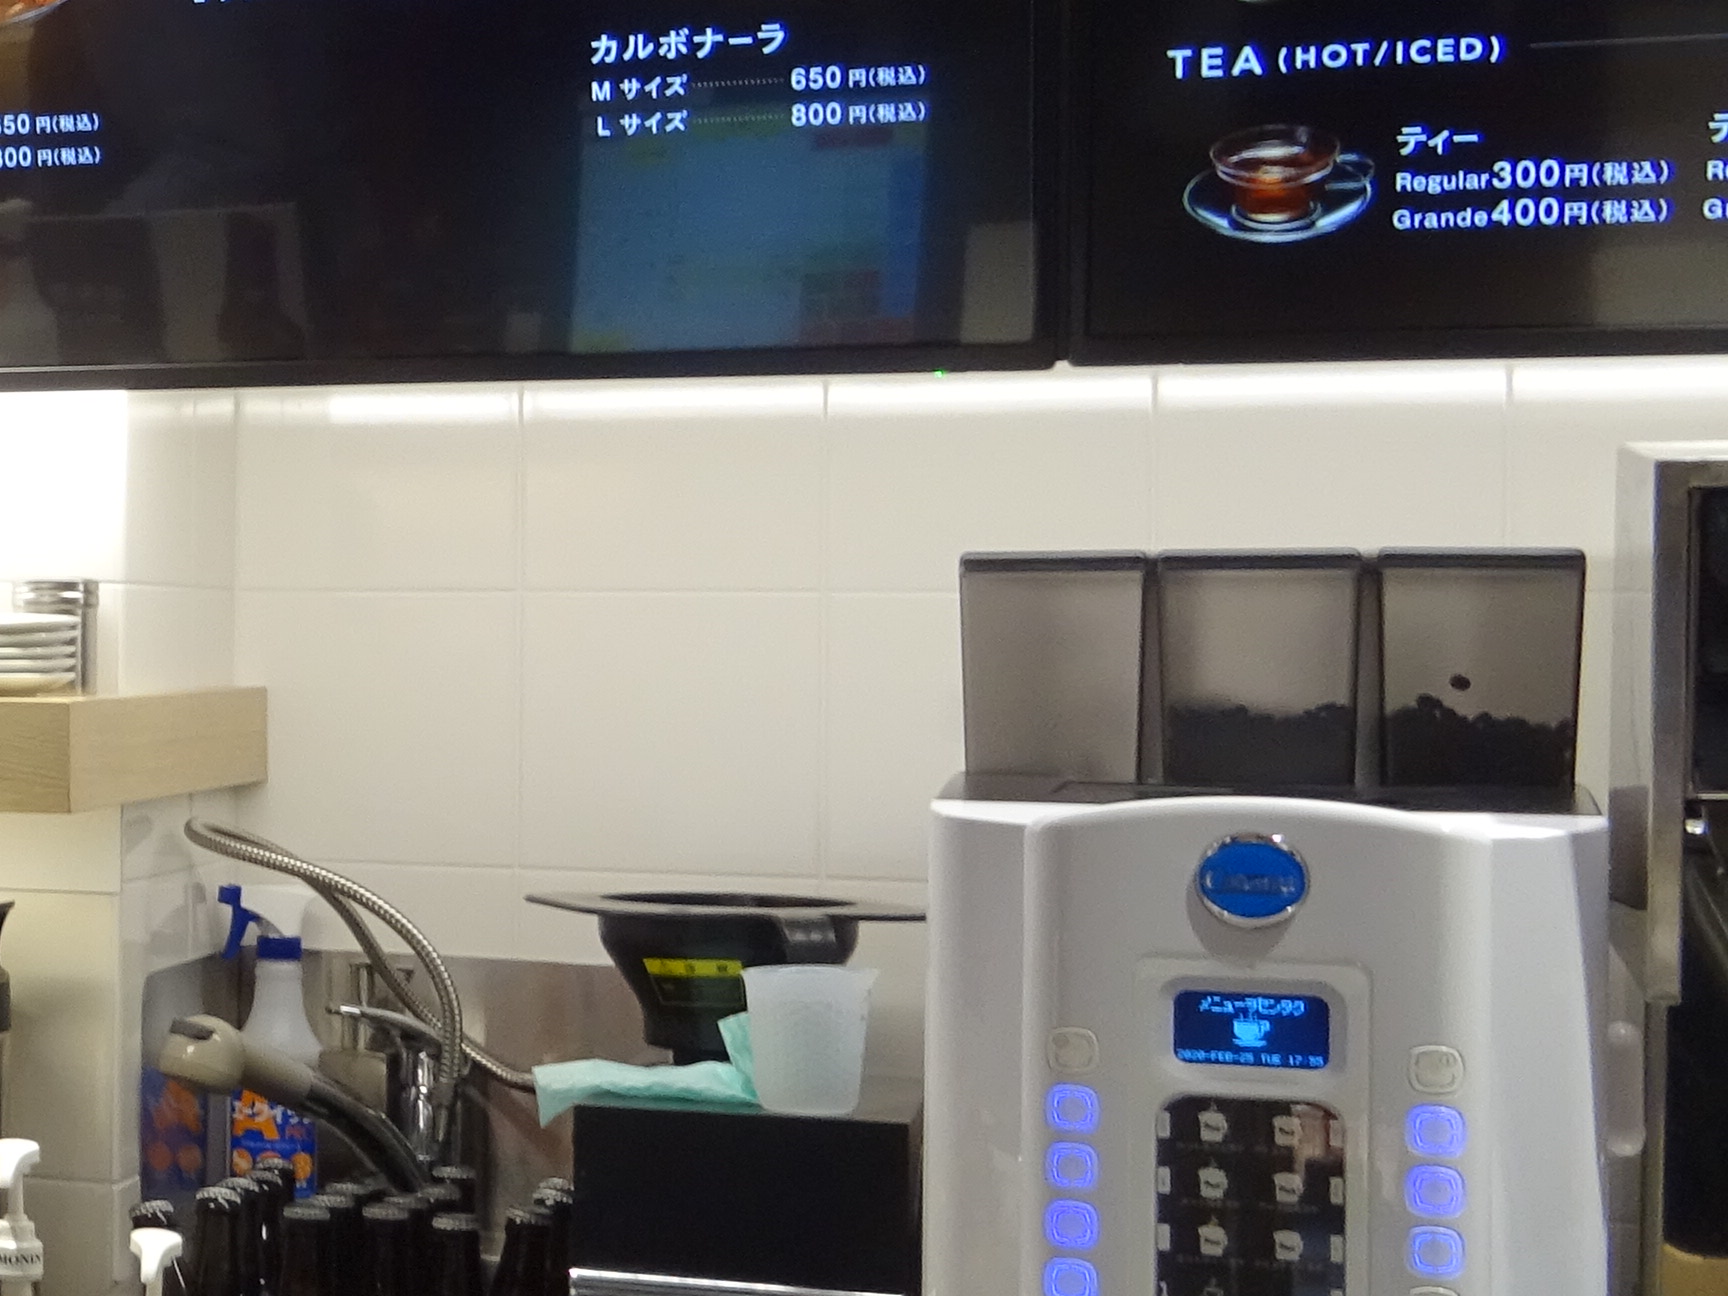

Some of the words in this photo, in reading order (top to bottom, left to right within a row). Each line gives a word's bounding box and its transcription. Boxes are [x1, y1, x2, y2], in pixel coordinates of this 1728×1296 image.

[590, 23, 786, 65] カルボナーラ
[1167, 44, 1264, 79] TEA
[1278, 35, 1502, 74] (HOT/ICED)
[790, 66, 842, 91] 650
[790, 102, 842, 127] 800
[1397, 125, 1479, 157] ティー
